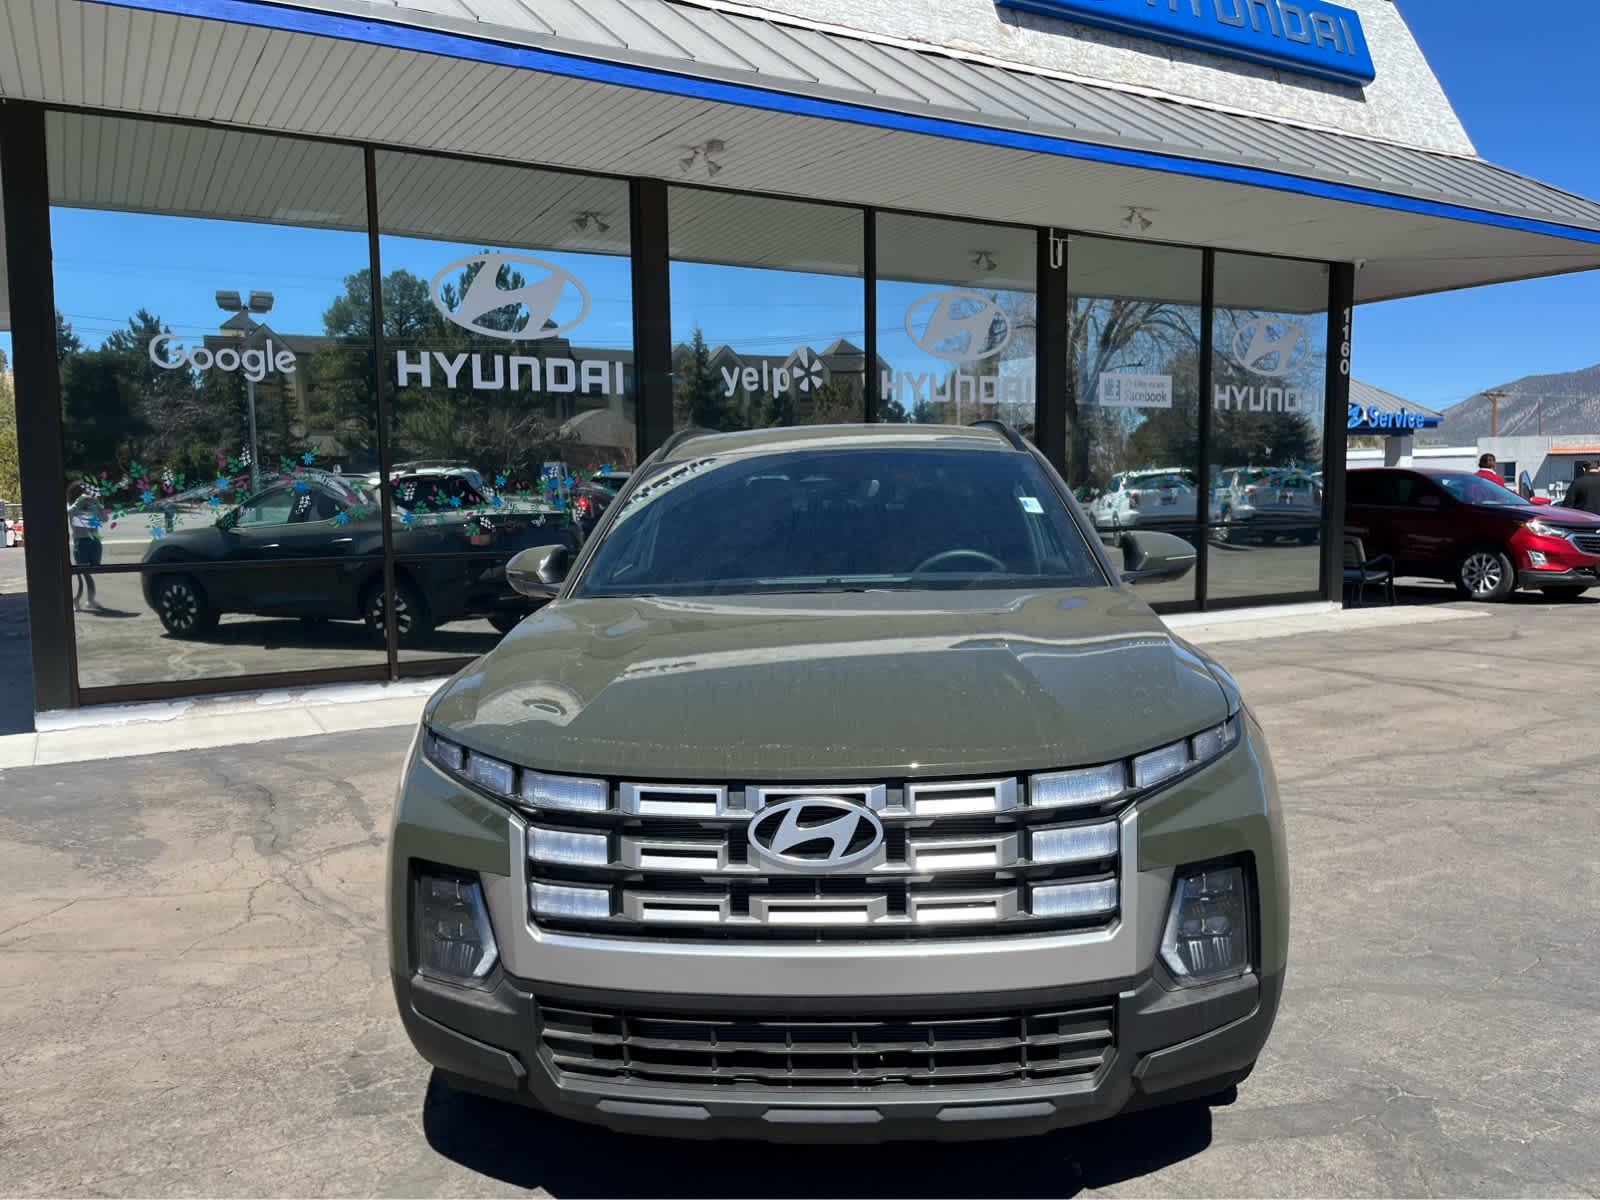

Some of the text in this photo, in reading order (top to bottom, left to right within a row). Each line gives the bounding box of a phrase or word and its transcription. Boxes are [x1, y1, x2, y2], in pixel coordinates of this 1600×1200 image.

[1147, 0, 1357, 56] UNDAI
[148, 333, 296, 382] Google
[1340, 307, 1350, 376] 1160
[397, 350, 625, 395] HYUNDAI
[721, 360, 790, 399] yelp
[881, 370, 1035, 405] HYUNDAI
[1367, 406, 1425, 429] Service
